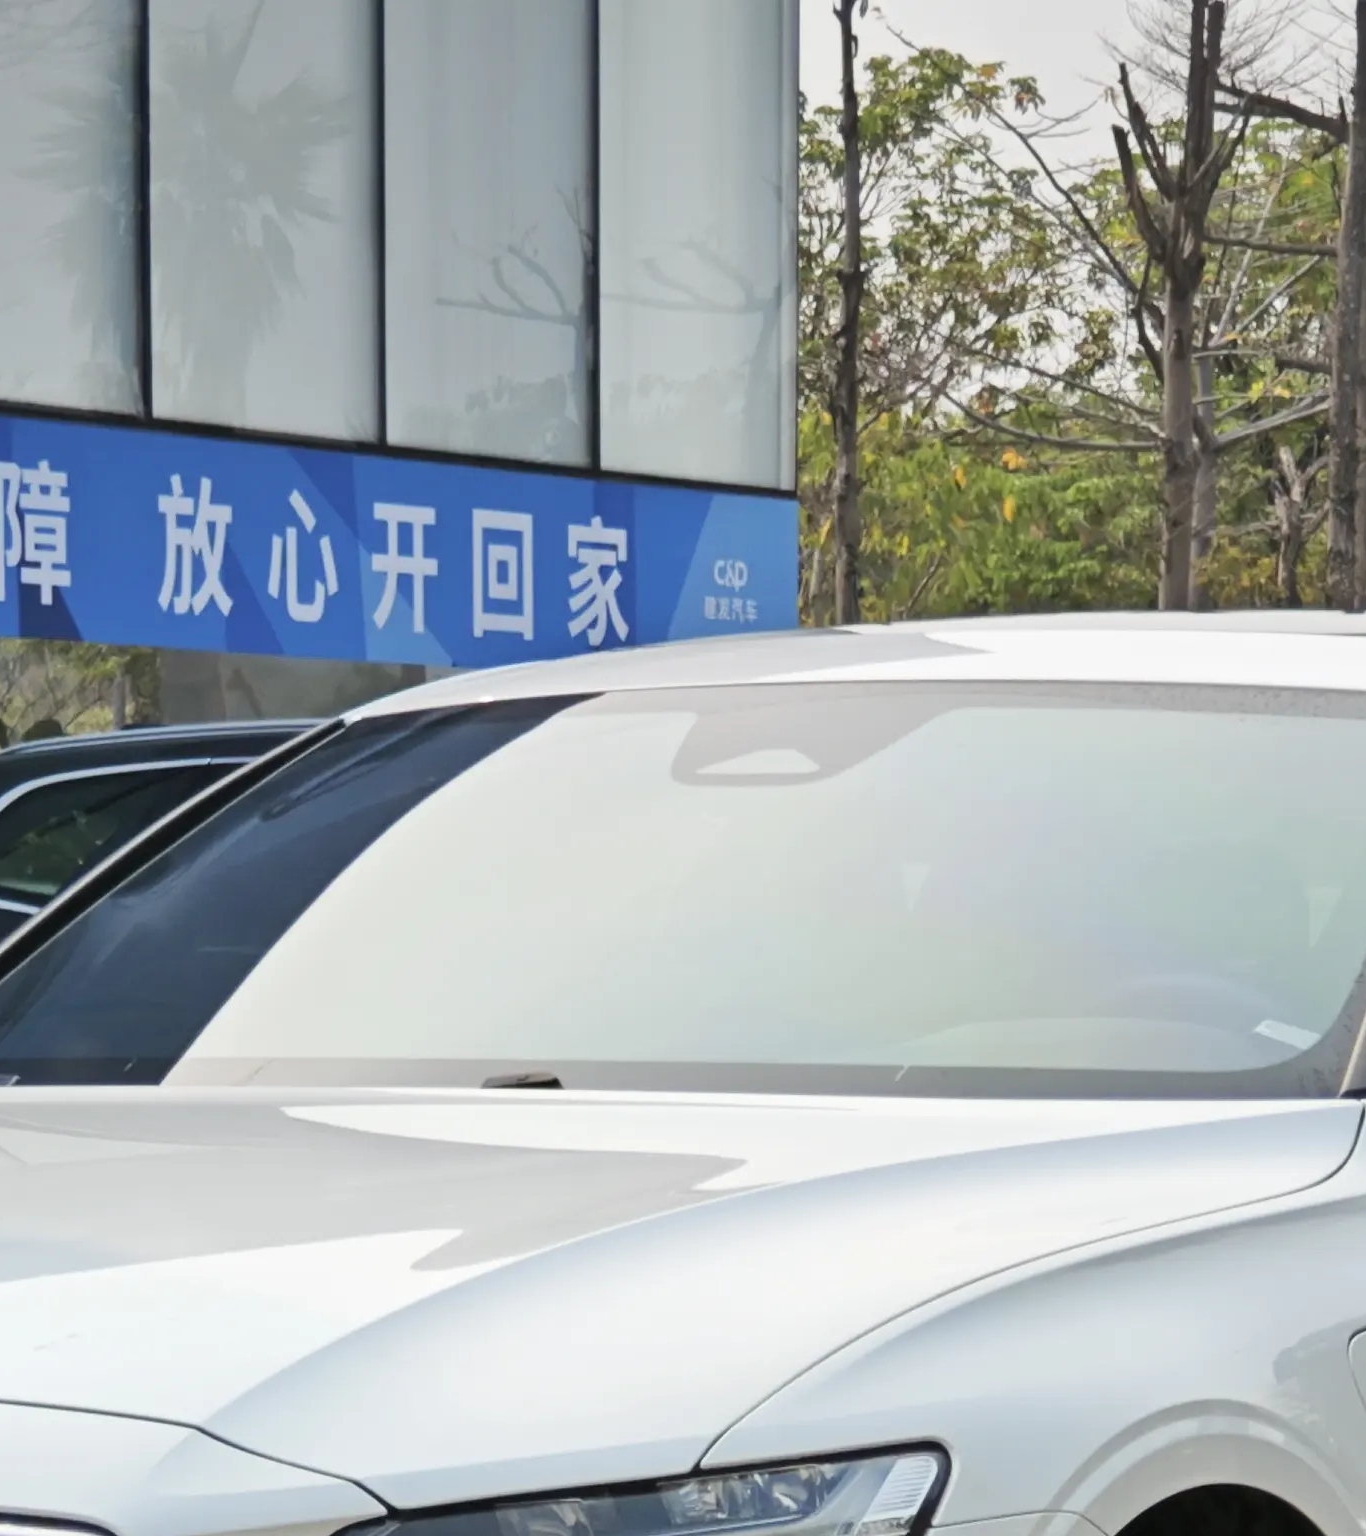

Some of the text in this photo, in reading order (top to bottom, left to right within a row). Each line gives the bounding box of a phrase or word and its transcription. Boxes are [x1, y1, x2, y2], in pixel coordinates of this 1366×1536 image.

[157, 473, 630, 646] 放心开回家
